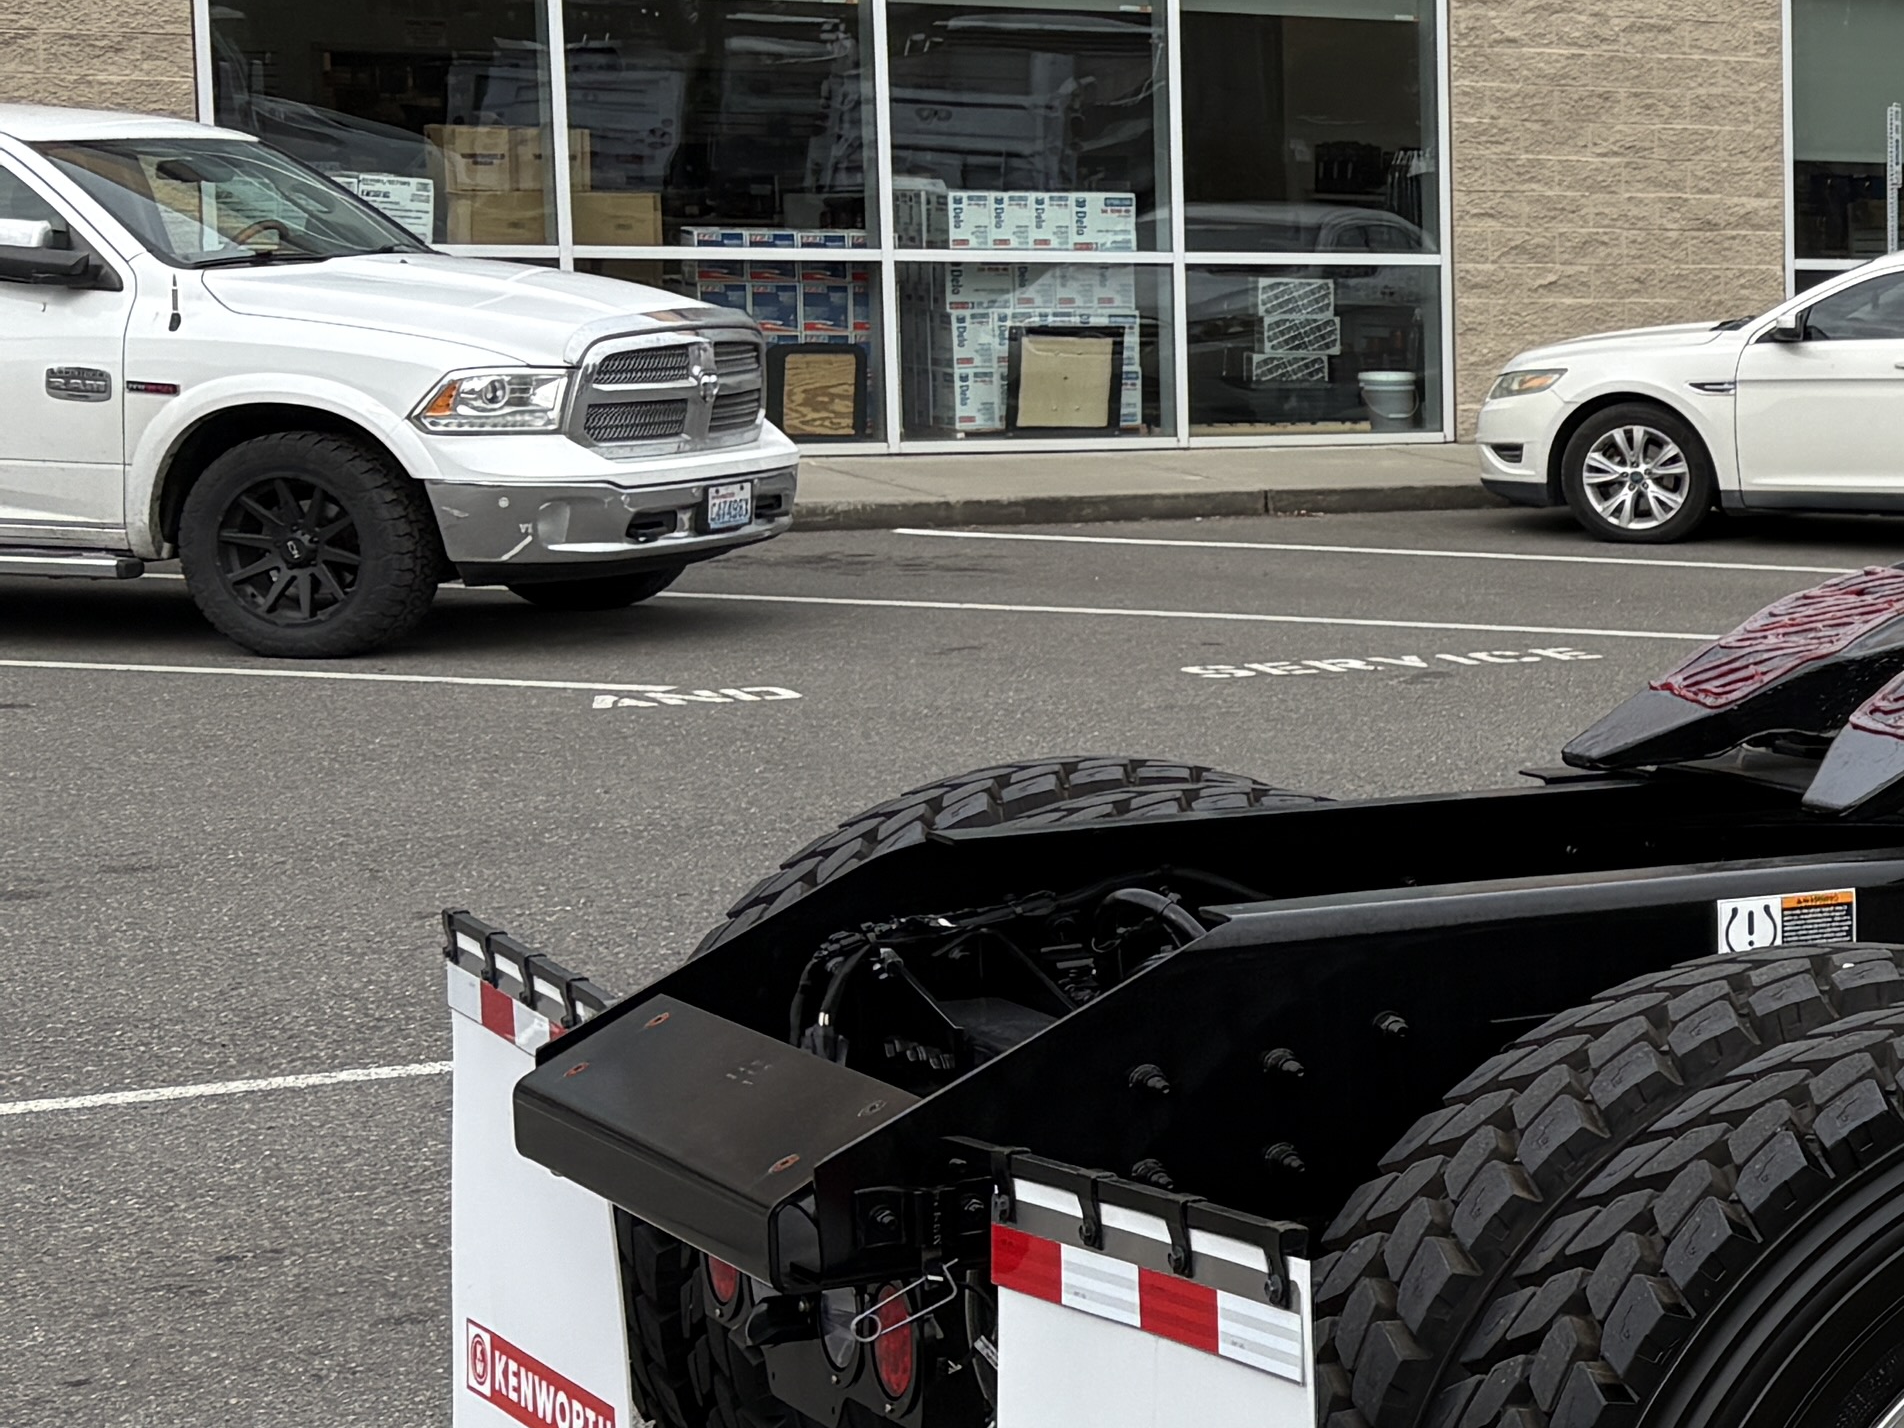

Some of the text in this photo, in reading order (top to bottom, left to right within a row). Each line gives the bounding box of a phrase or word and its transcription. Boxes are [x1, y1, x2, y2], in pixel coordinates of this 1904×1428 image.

[953, 207, 963, 229] Delo
[995, 207, 1004, 229] Delo
[1035, 207, 1045, 229] Delo
[1075, 210, 1087, 236] Delo
[951, 269, 963, 295] Delo
[1180, 647, 1604, 678] SERVICE
[592, 686, 803, 709] AND
